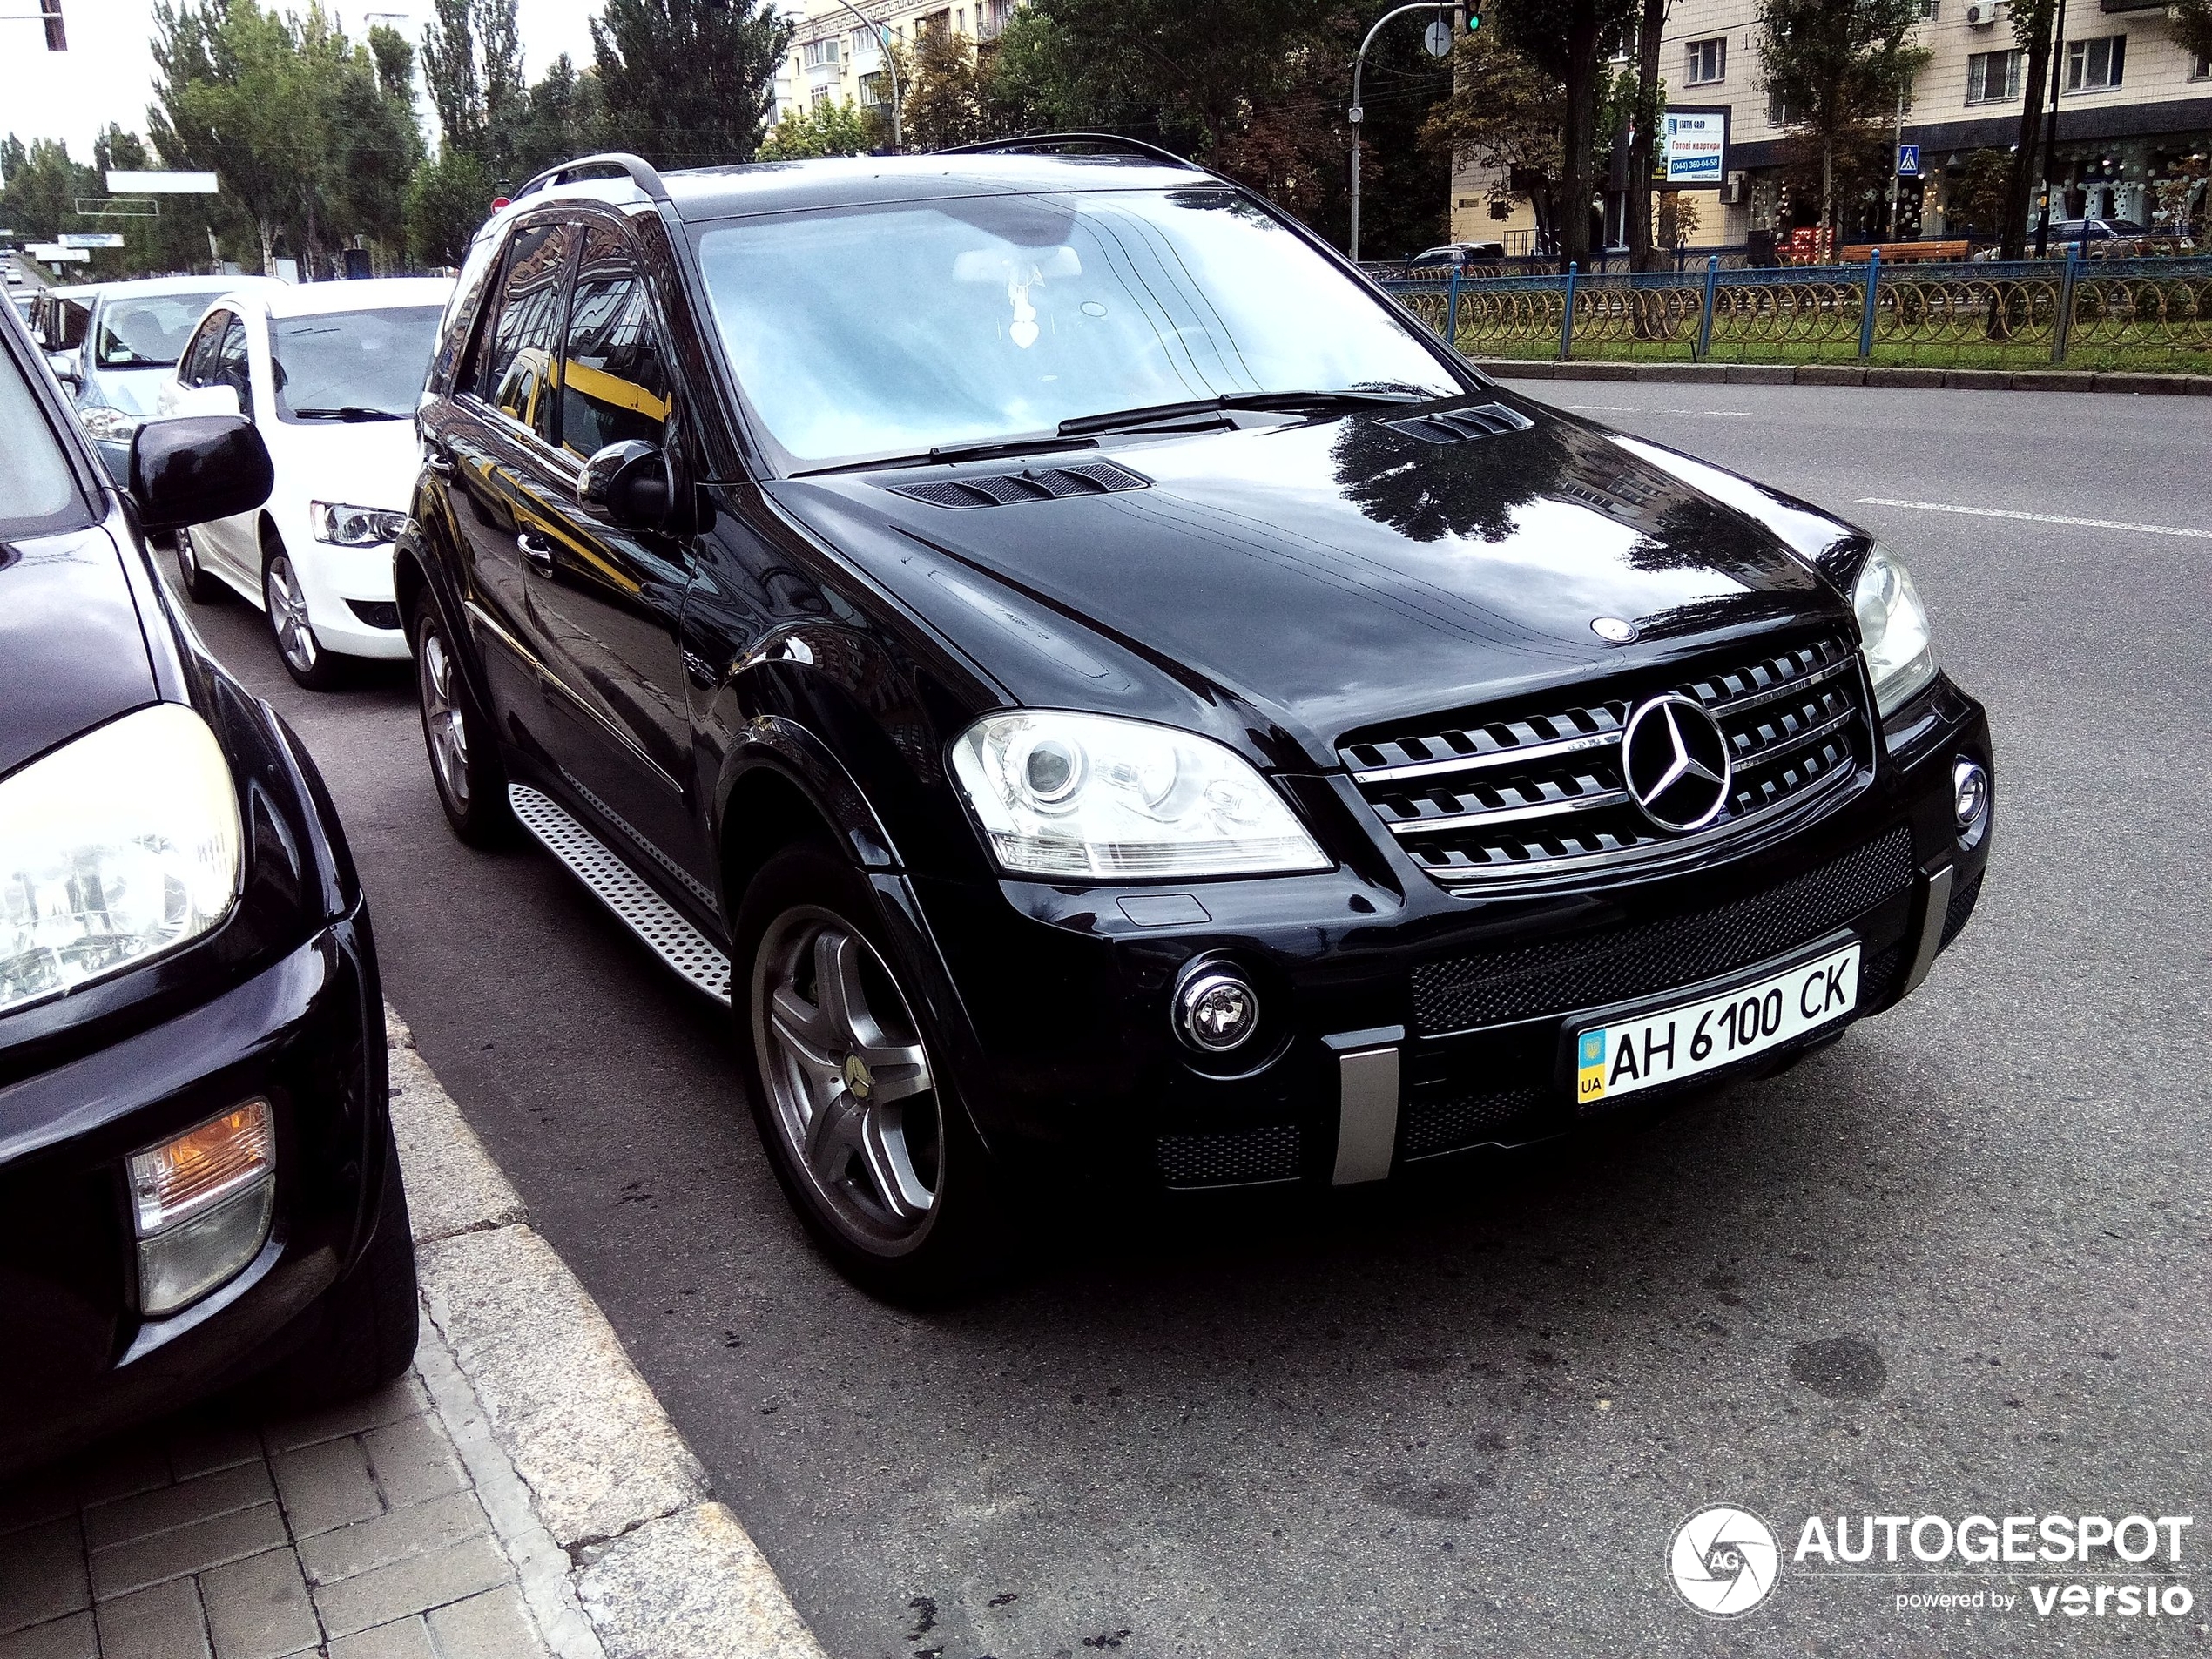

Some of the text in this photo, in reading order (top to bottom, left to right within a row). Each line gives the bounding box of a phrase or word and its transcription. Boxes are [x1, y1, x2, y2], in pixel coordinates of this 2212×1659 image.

[1672, 141, 1721, 152] Готові квартири
[1672, 163, 1688, 172] (044)
[1609, 957, 1850, 1086] AH 6100 CK
[1581, 1079, 1602, 1094] UA
